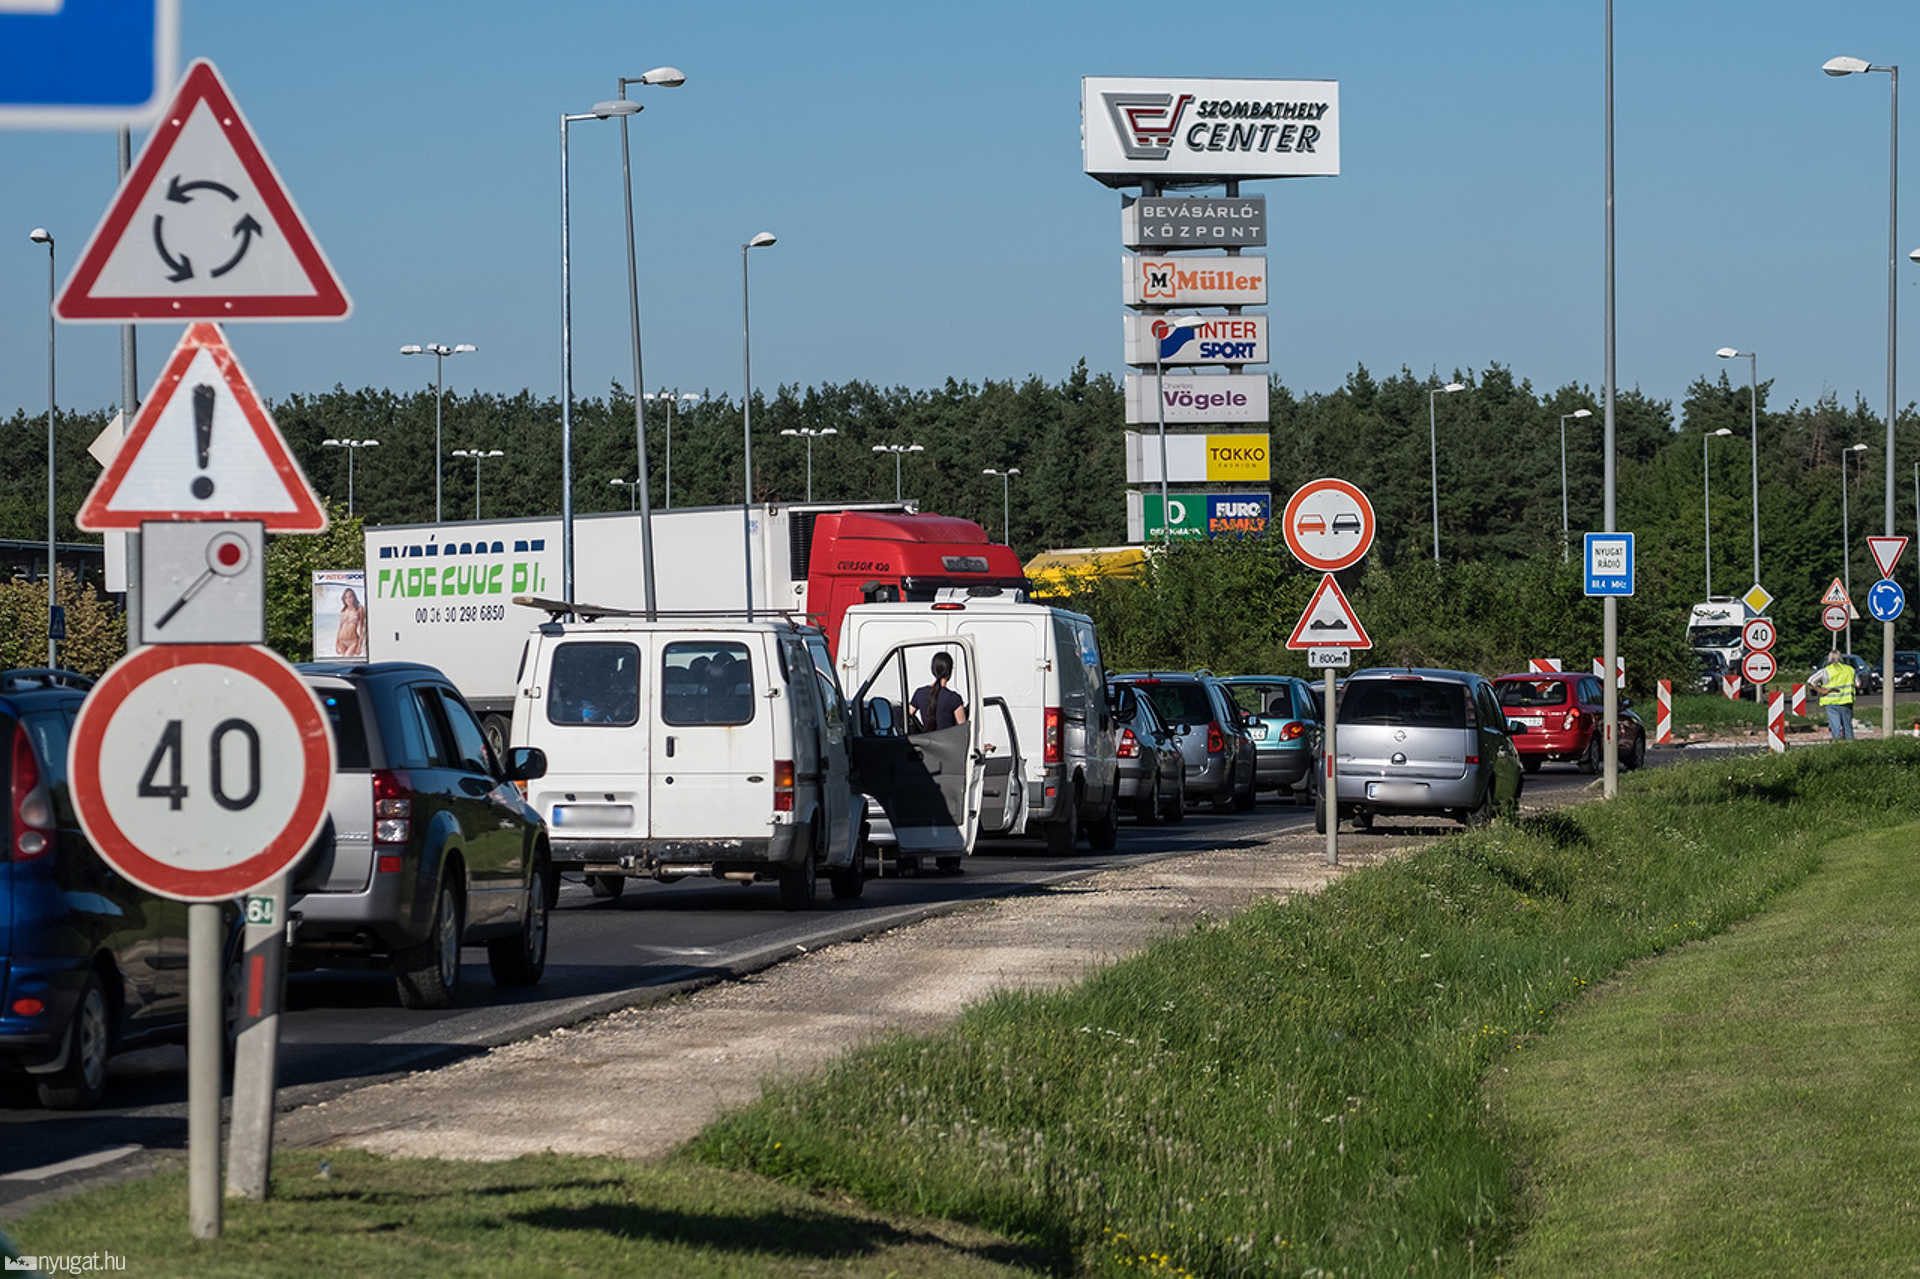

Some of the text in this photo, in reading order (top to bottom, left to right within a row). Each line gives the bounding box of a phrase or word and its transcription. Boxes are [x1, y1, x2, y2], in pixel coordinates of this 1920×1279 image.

[1196, 99, 1329, 120] SZOMBATHELY
[1186, 122, 1321, 154] CENTER
[1143, 203, 1260, 218] BEVÁSÁRLÓ-
[1143, 224, 1260, 238] KÖZPONT
[1151, 270, 1262, 291] M Müller
[1199, 321, 1257, 339] INTER
[1199, 342, 1257, 359] SPORT
[1163, 390, 1247, 410] Vögele
[415, 607, 428, 624] 00
[459, 605, 477, 622] 298
[479, 604, 505, 622] 6850
[1751, 629, 1768, 641] 40
[137, 717, 262, 812] 40
